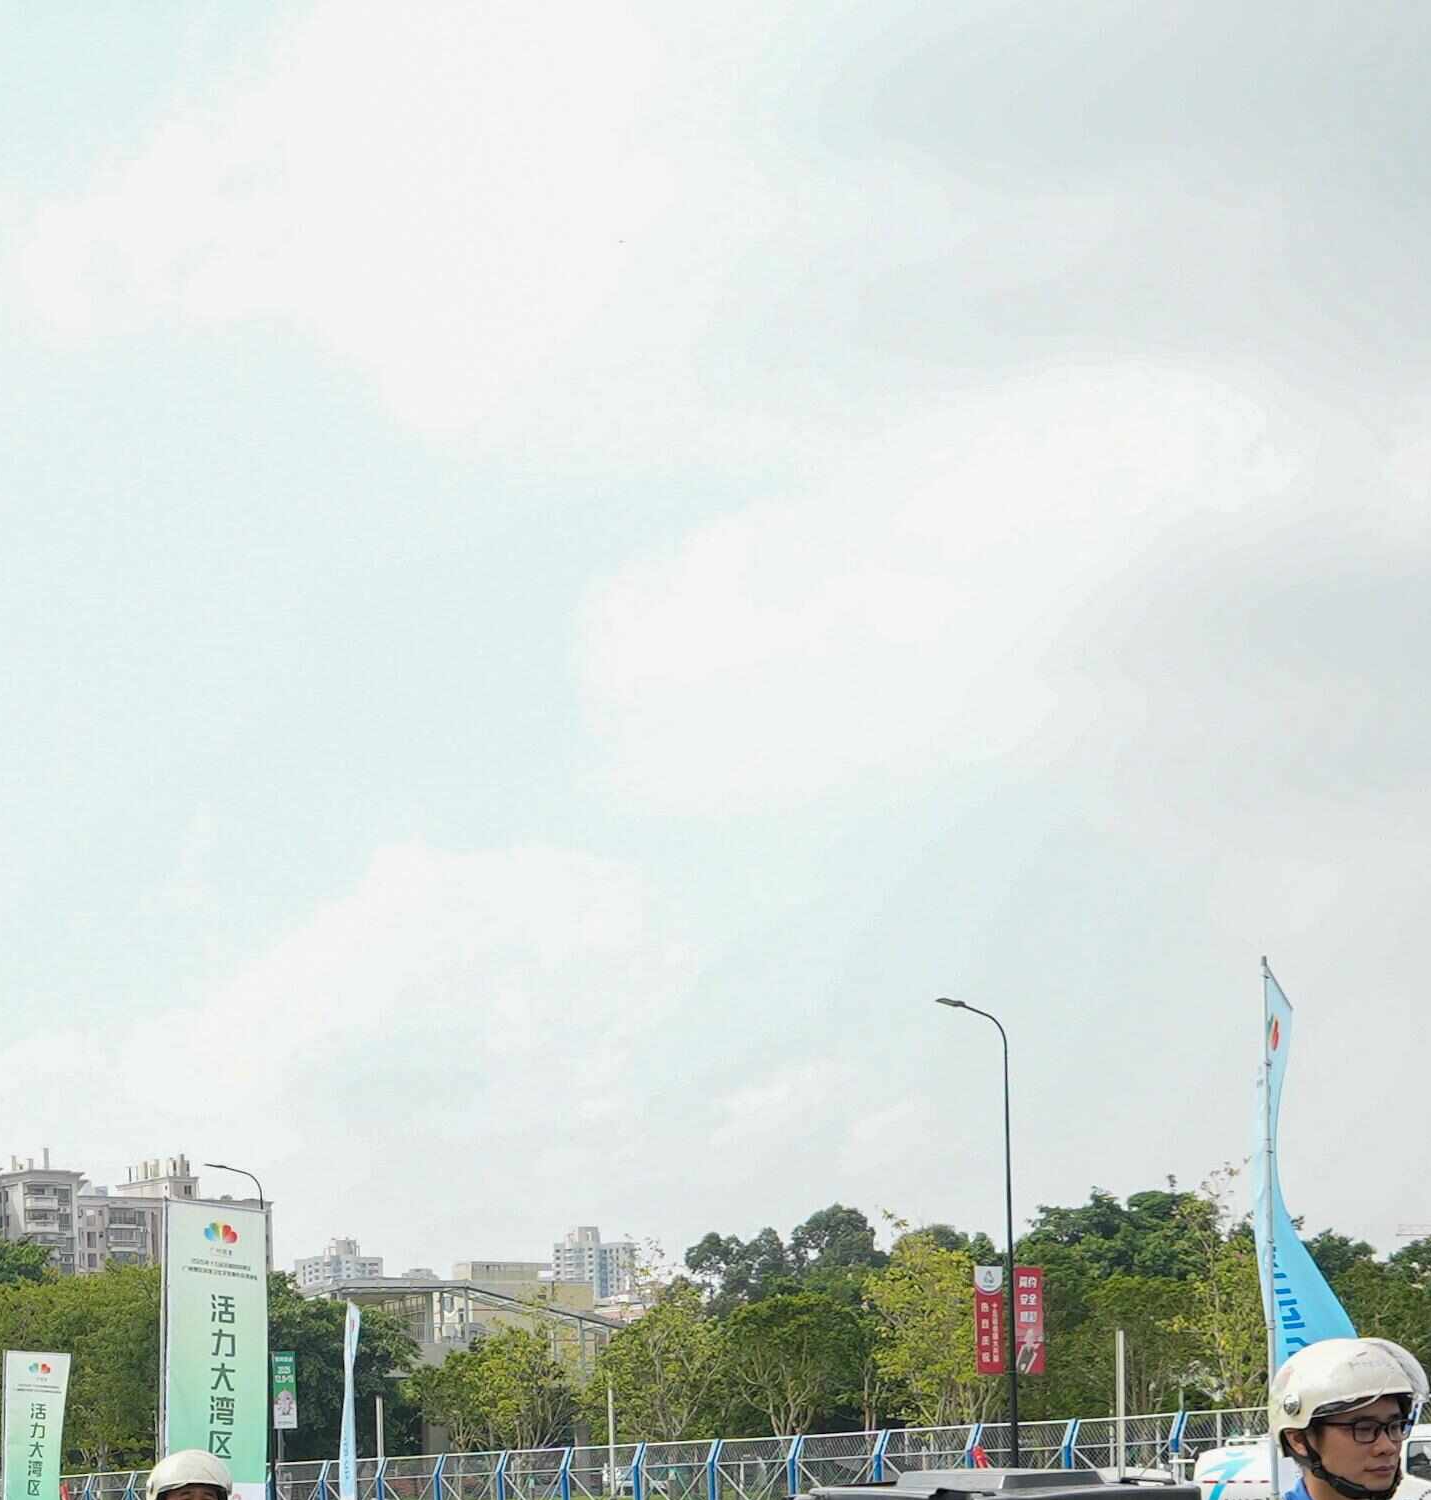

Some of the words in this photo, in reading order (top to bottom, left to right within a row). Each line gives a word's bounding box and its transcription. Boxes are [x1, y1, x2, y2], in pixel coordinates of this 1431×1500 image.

[208, 1293, 236, 1460] 活力大湾区
[27, 1402, 47, 1497] 活力大湾区
